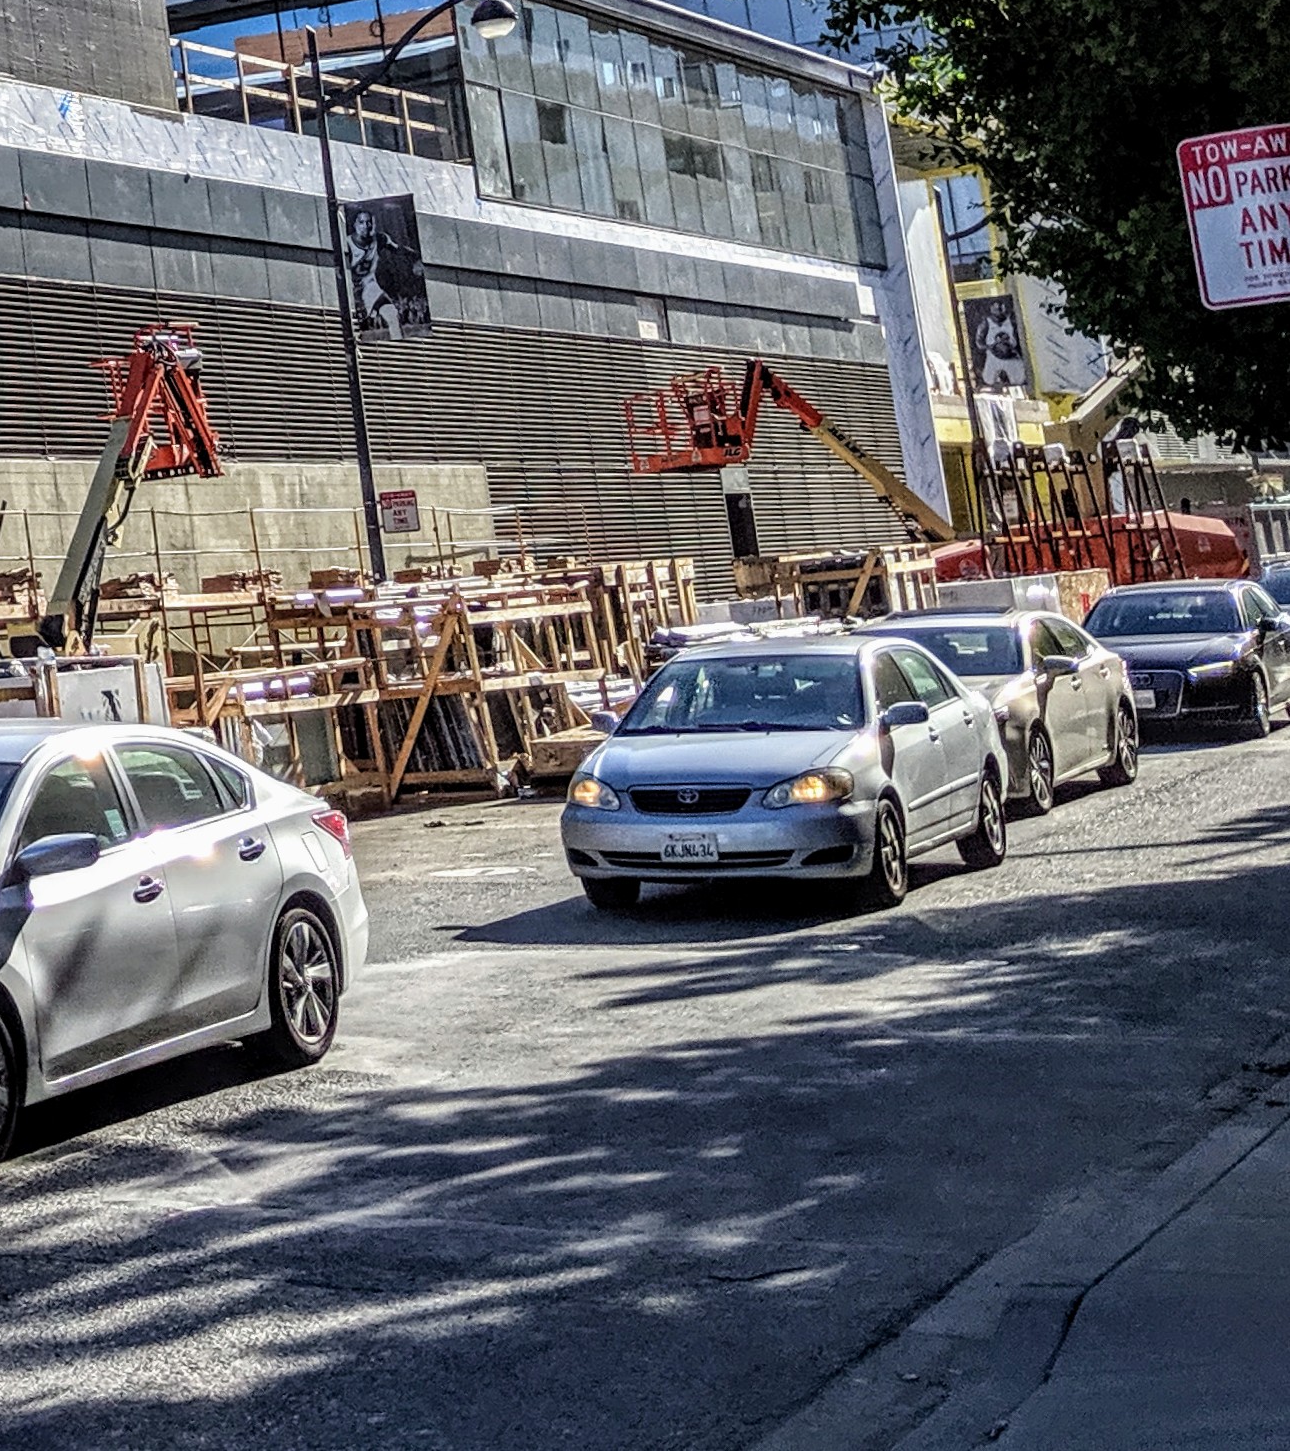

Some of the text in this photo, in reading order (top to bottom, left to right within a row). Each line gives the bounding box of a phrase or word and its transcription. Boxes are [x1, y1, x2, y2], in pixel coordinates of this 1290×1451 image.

[1191, 132, 1288, 165] TOW-AW
[1188, 165, 1290, 206] NO PARK
[1239, 237, 1290, 269] TIM
